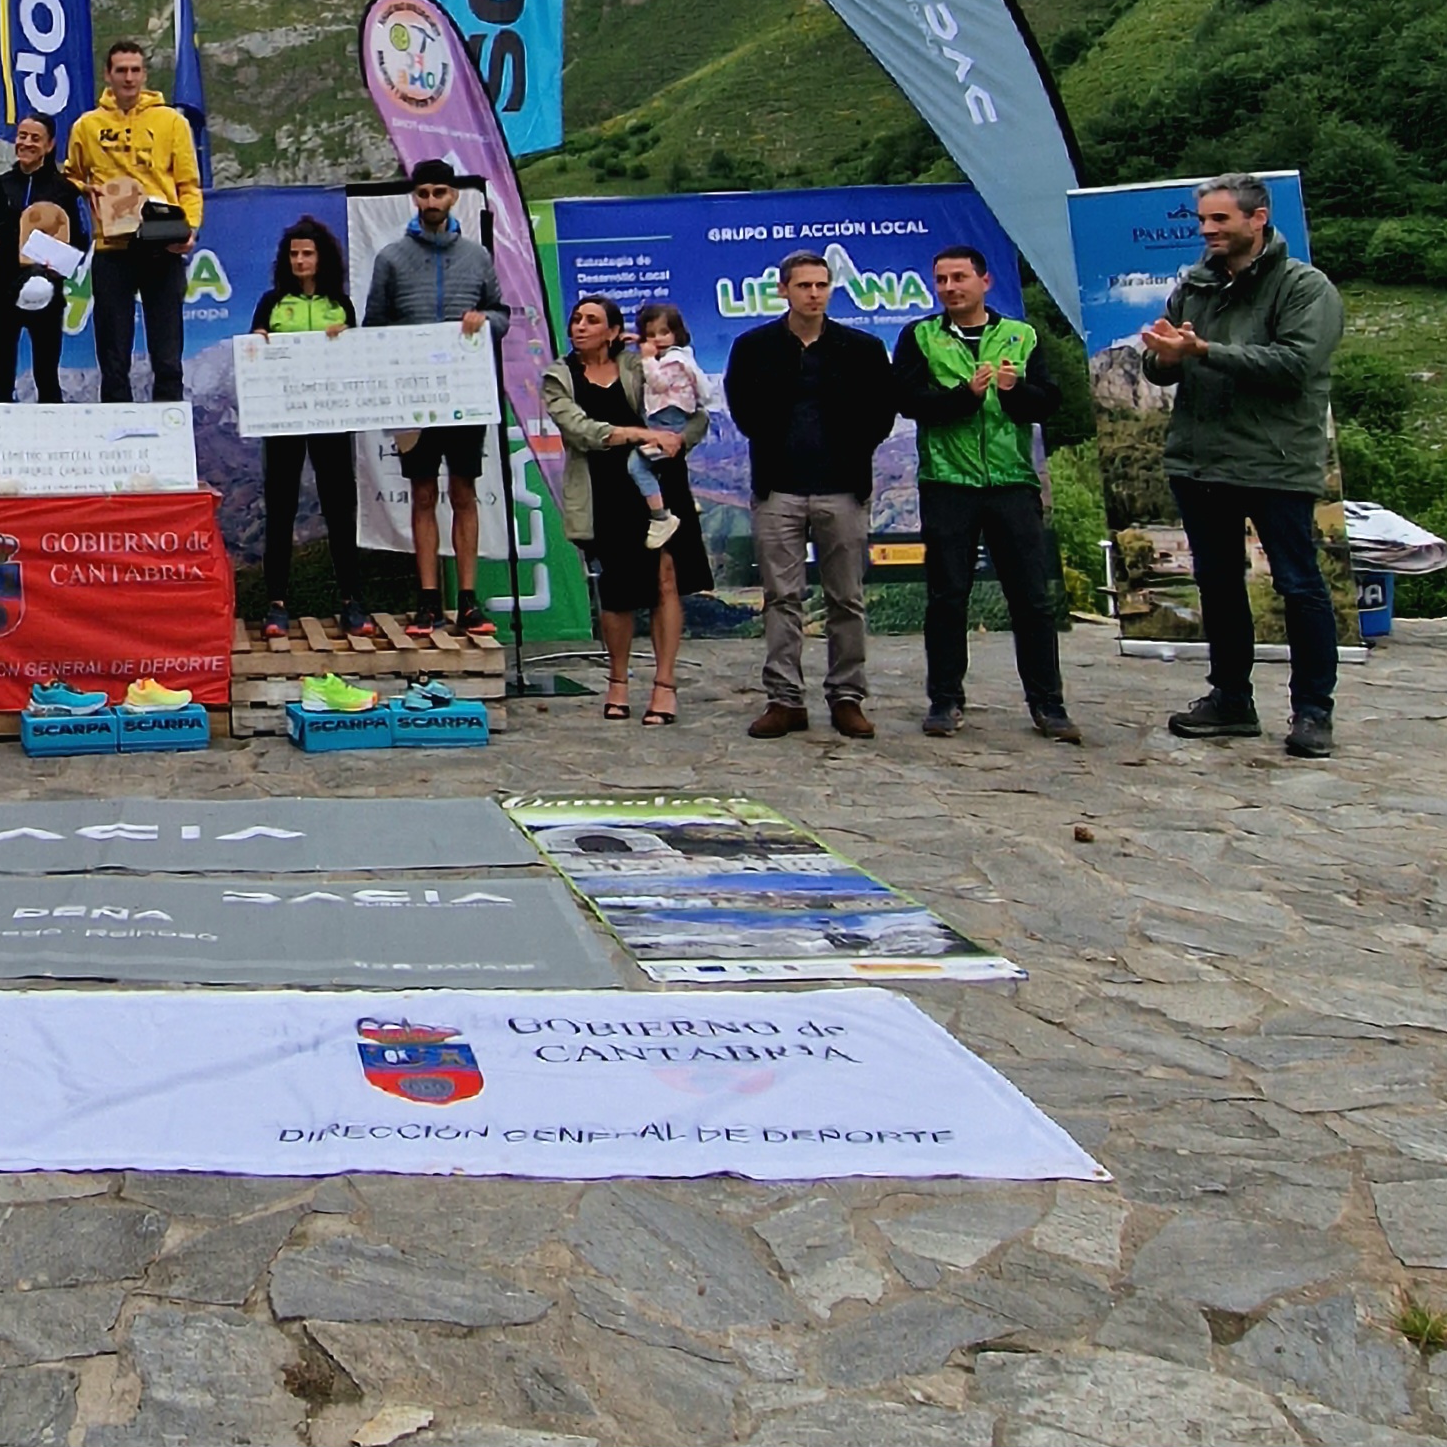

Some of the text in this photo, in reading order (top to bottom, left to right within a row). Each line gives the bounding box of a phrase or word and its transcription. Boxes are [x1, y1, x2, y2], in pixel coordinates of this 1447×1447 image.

[708, 218, 929, 241] GRUPO DE ACCIÓN LOCAL
[639, 269, 670, 281] Local
[41, 532, 179, 554] GOBIERNO
[49, 563, 205, 585] CANTABRIA
[24, 659, 104, 678] GENERAL
[111, 658, 134, 675] DE
[139, 655, 226, 675] DEPORTE
[32, 722, 112, 736] SCARPA
[122, 717, 203, 733] SCARPA
[308, 717, 389, 733] SCARPA
[397, 716, 484, 729] SCARPA
[222, 889, 514, 903] DACIA
[12, 905, 174, 922] PEÑA
[534, 1044, 864, 1065] CANTABRIA
